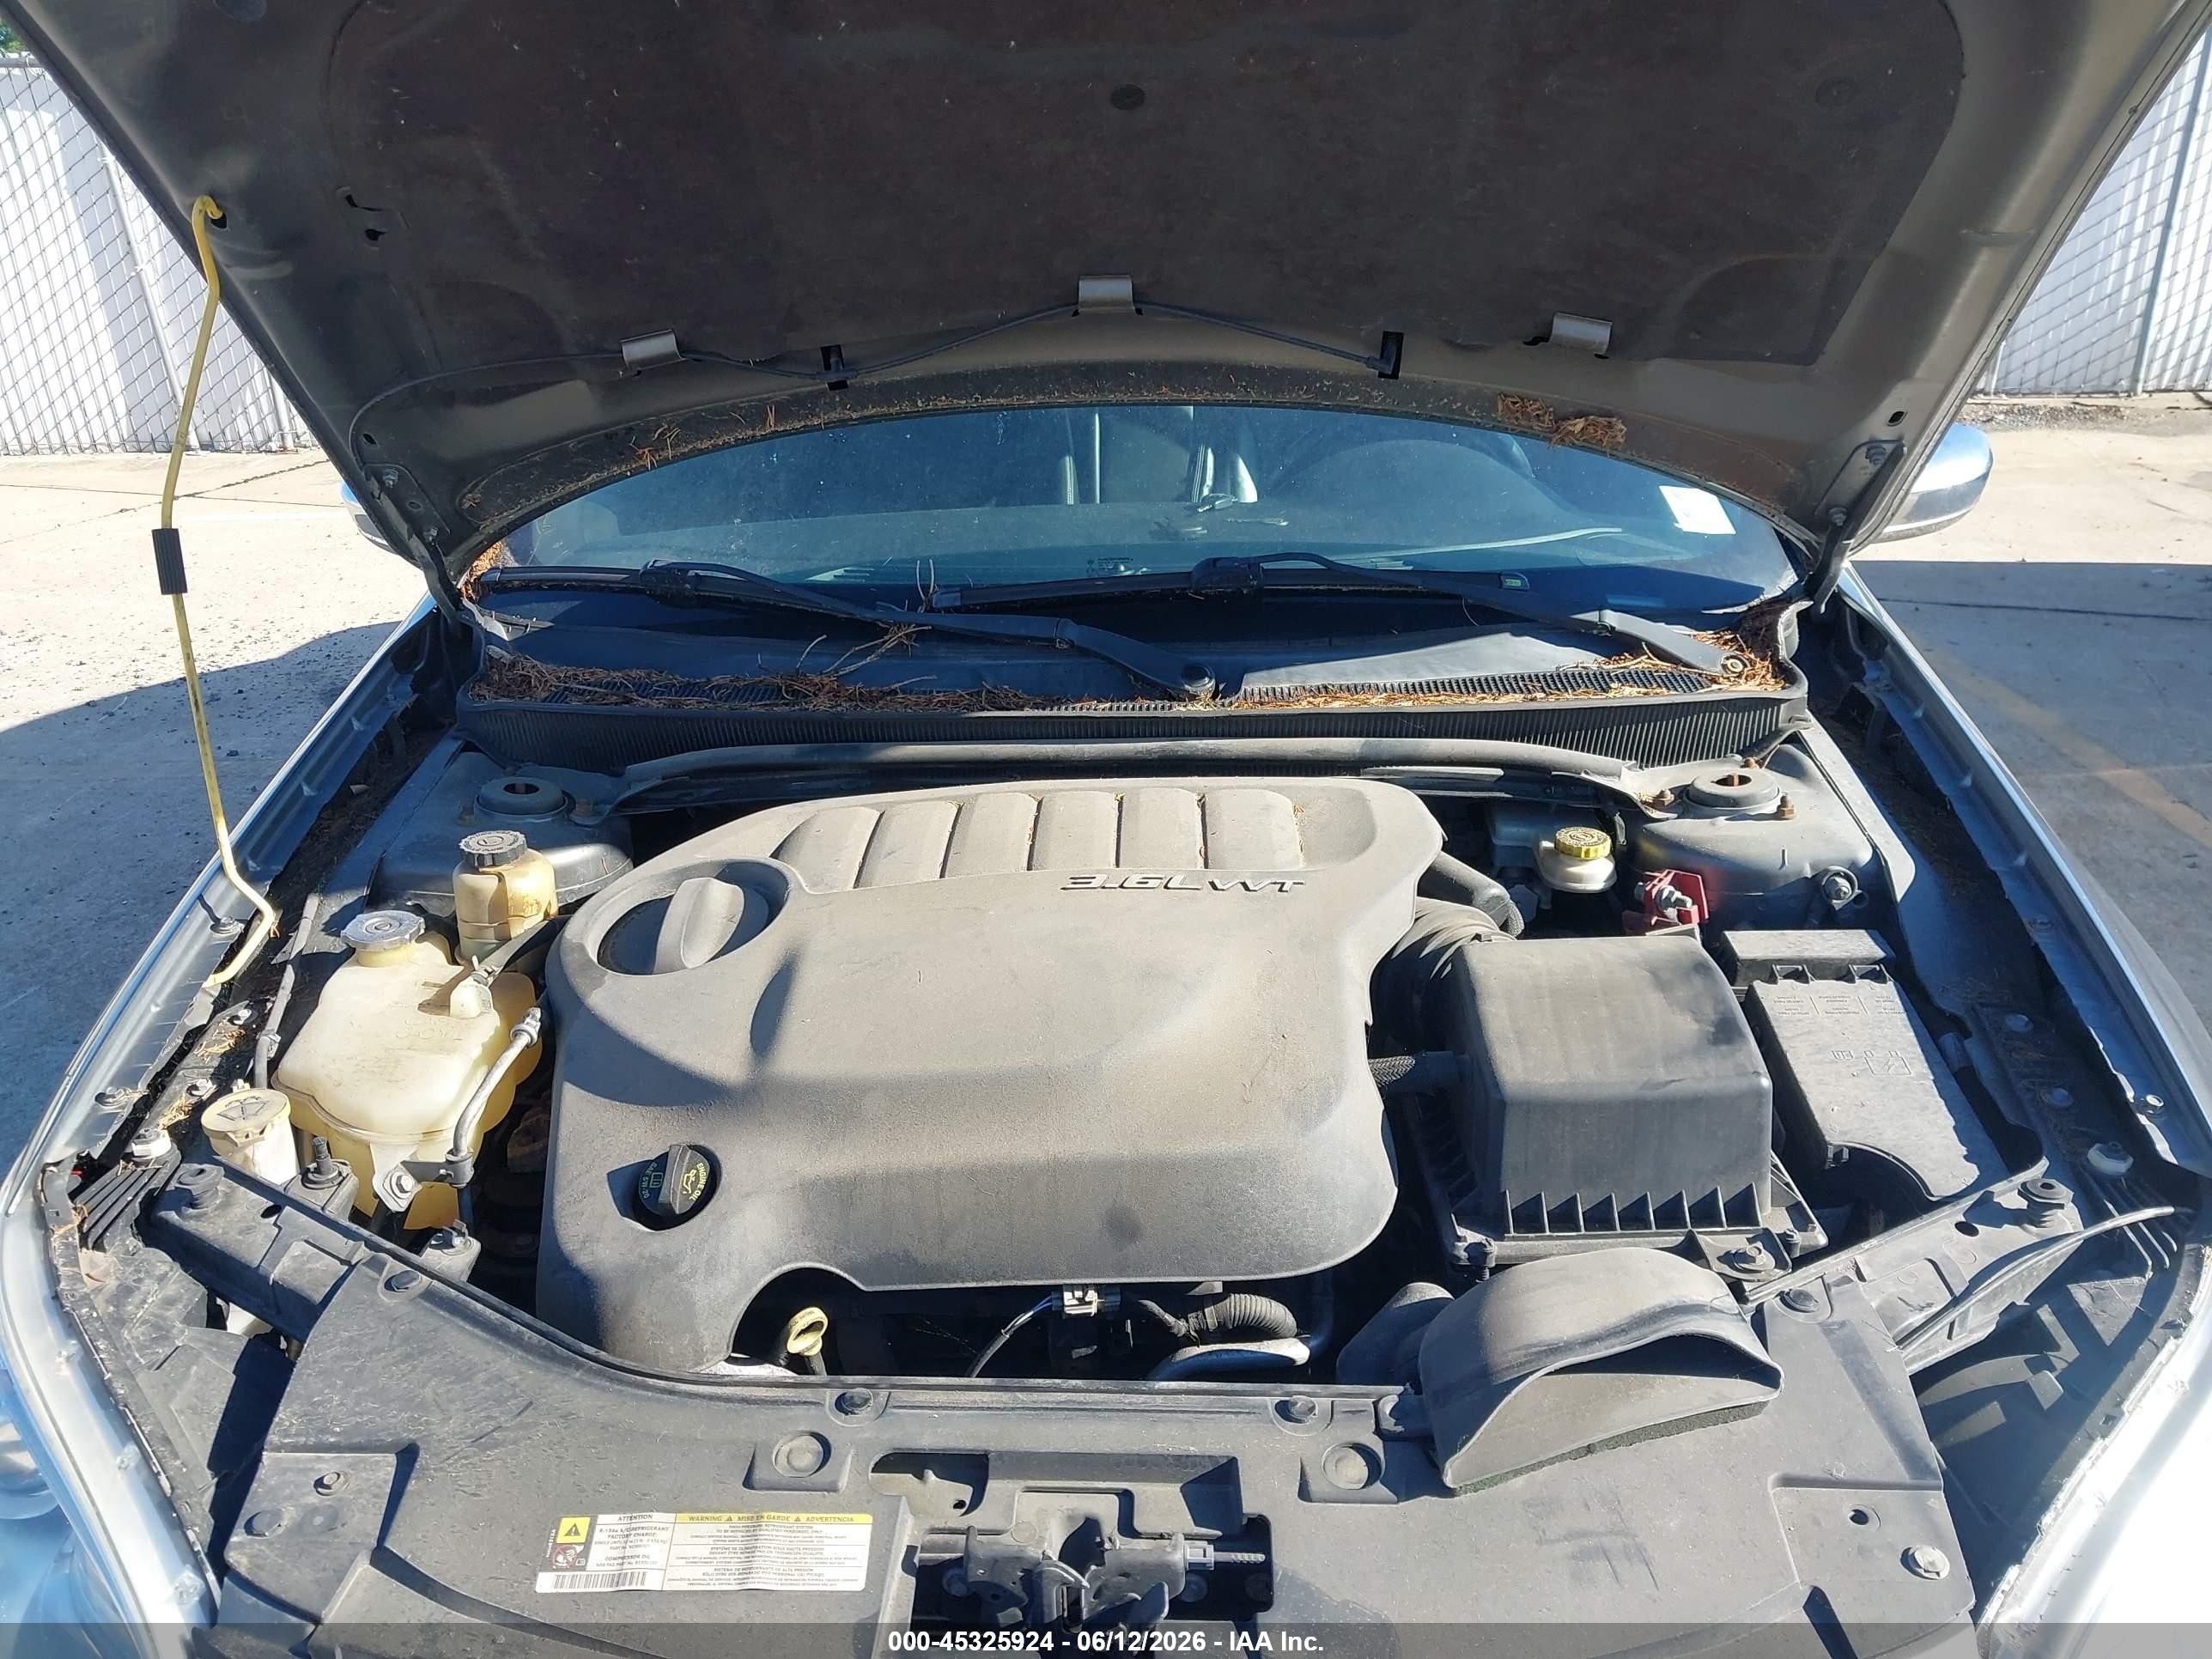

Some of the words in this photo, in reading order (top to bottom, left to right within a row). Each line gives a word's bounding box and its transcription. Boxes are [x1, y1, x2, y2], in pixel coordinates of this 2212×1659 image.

[1060, 873, 1202, 890] 3.6L
[1207, 879, 1305, 893] VVT
[696, 1162, 707, 1190] ENGINE
[689, 1189, 702, 1201] OIL
[617, 1514, 653, 1522] ATTENTION
